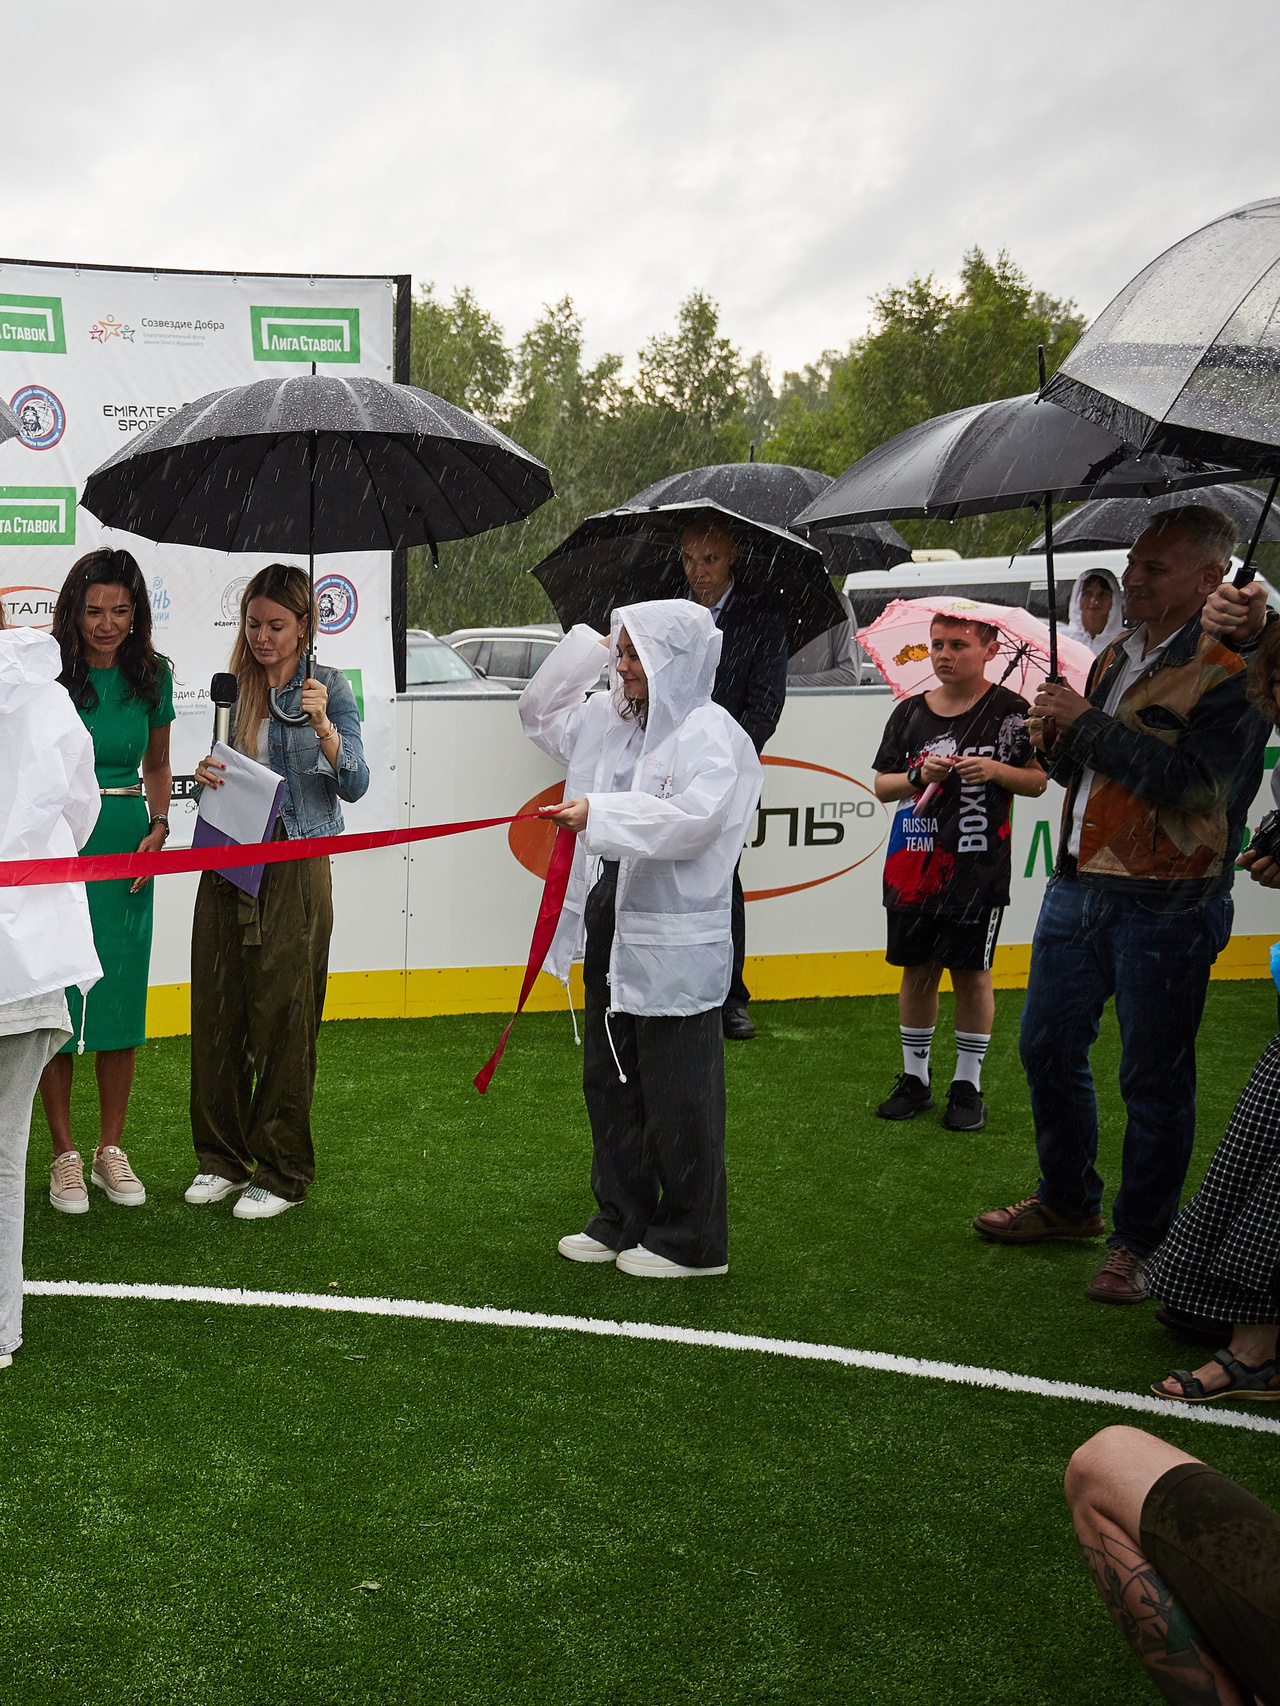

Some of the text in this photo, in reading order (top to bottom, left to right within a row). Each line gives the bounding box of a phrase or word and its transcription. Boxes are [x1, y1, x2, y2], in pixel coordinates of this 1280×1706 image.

[2, 323, 47, 341] СТАВОК
[141, 317, 225, 332] Созвездие Добра
[271, 334, 342, 352] ЛИГА СТАВОК
[13, 516, 57, 533] СТАВОК
[958, 745, 996, 853] BOXIG
[820, 801, 875, 819] ПРО
[902, 818, 938, 833] RUSSIA
[905, 837, 934, 852] TEAM
